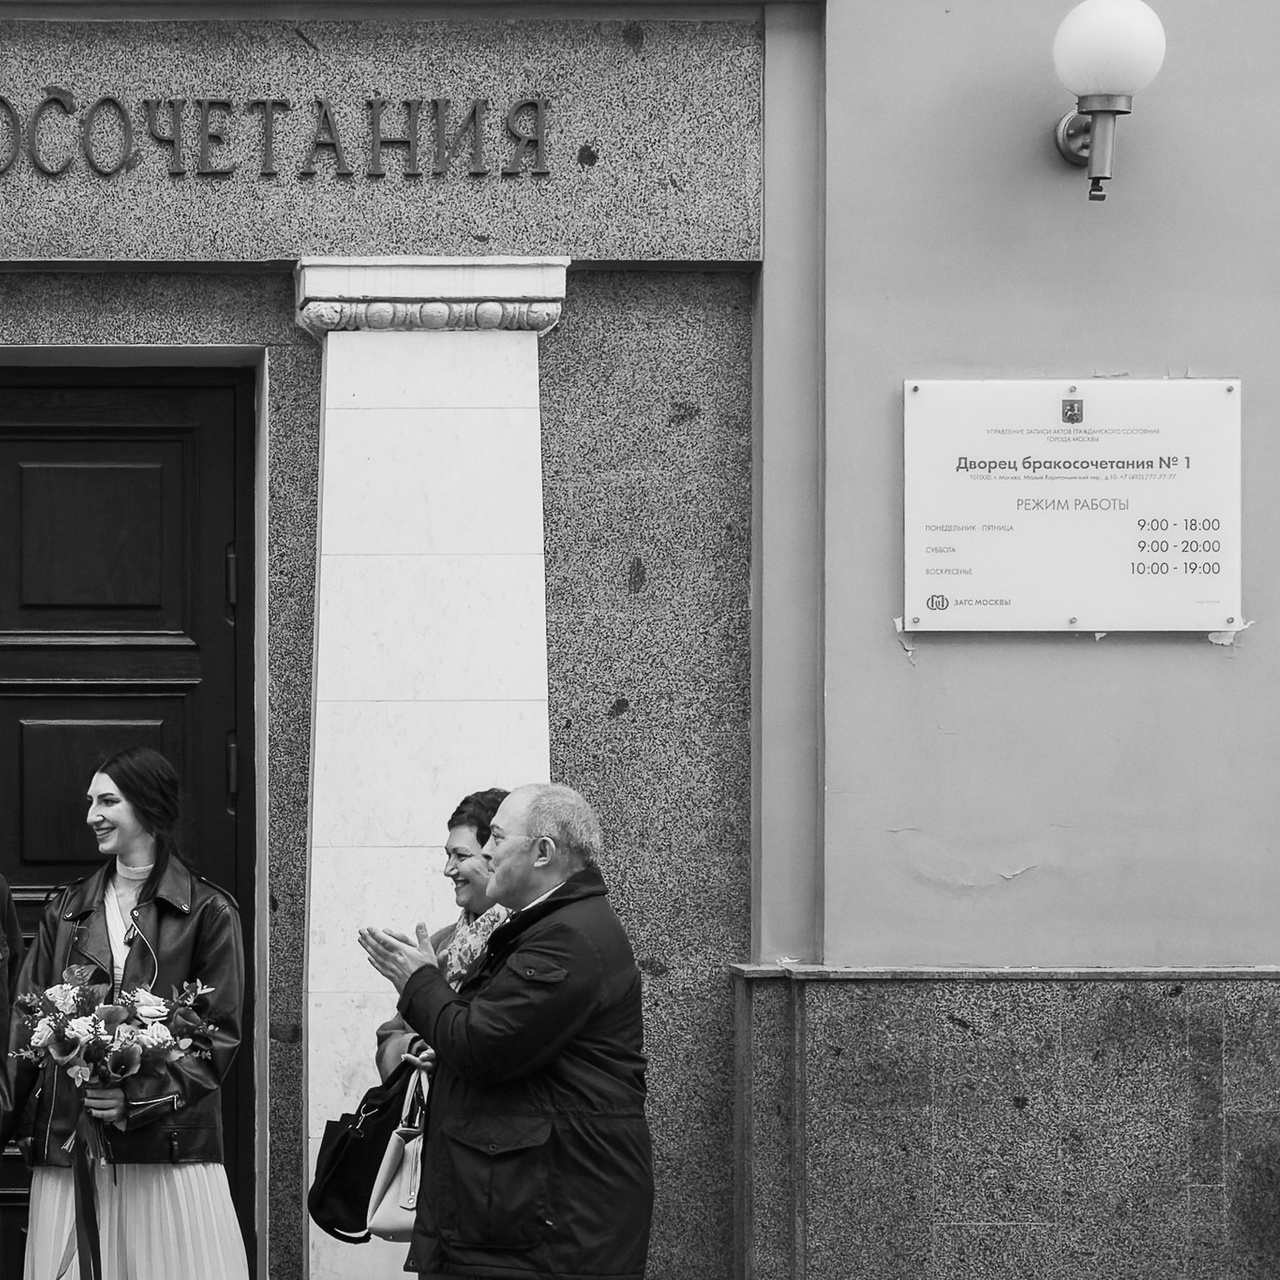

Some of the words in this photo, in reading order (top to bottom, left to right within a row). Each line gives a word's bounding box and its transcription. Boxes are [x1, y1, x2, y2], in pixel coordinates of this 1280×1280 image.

[956, 456, 1018, 473] Дворец
[1022, 455, 1154, 473] бракосочетания
[1158, 456, 1179, 470] №
[1185, 456, 1191, 470] 1
[1016, 498, 1070, 511] РЕЖИМ
[1074, 498, 1129, 511] РАБОТЫ
[925, 524, 977, 532] ПОНЕДЕЛЬНИК
[981, 524, 1014, 532] ПЯТНИЦА
[1137, 518, 1169, 532] 9:00
[1183, 518, 1221, 532] 18:00
[925, 546, 956, 554] СУББОТА
[1137, 540, 1169, 553] 9:00
[1180, 540, 1221, 553] 20:00
[925, 568, 973, 576] ВОСКРЕСЕНЬЕ
[1131, 562, 1169, 575] 10:00
[1183, 561, 1221, 575] 19:00
[954, 598, 974, 607] ЗАГС
[974, 598, 1012, 607] МОСКВЫ
